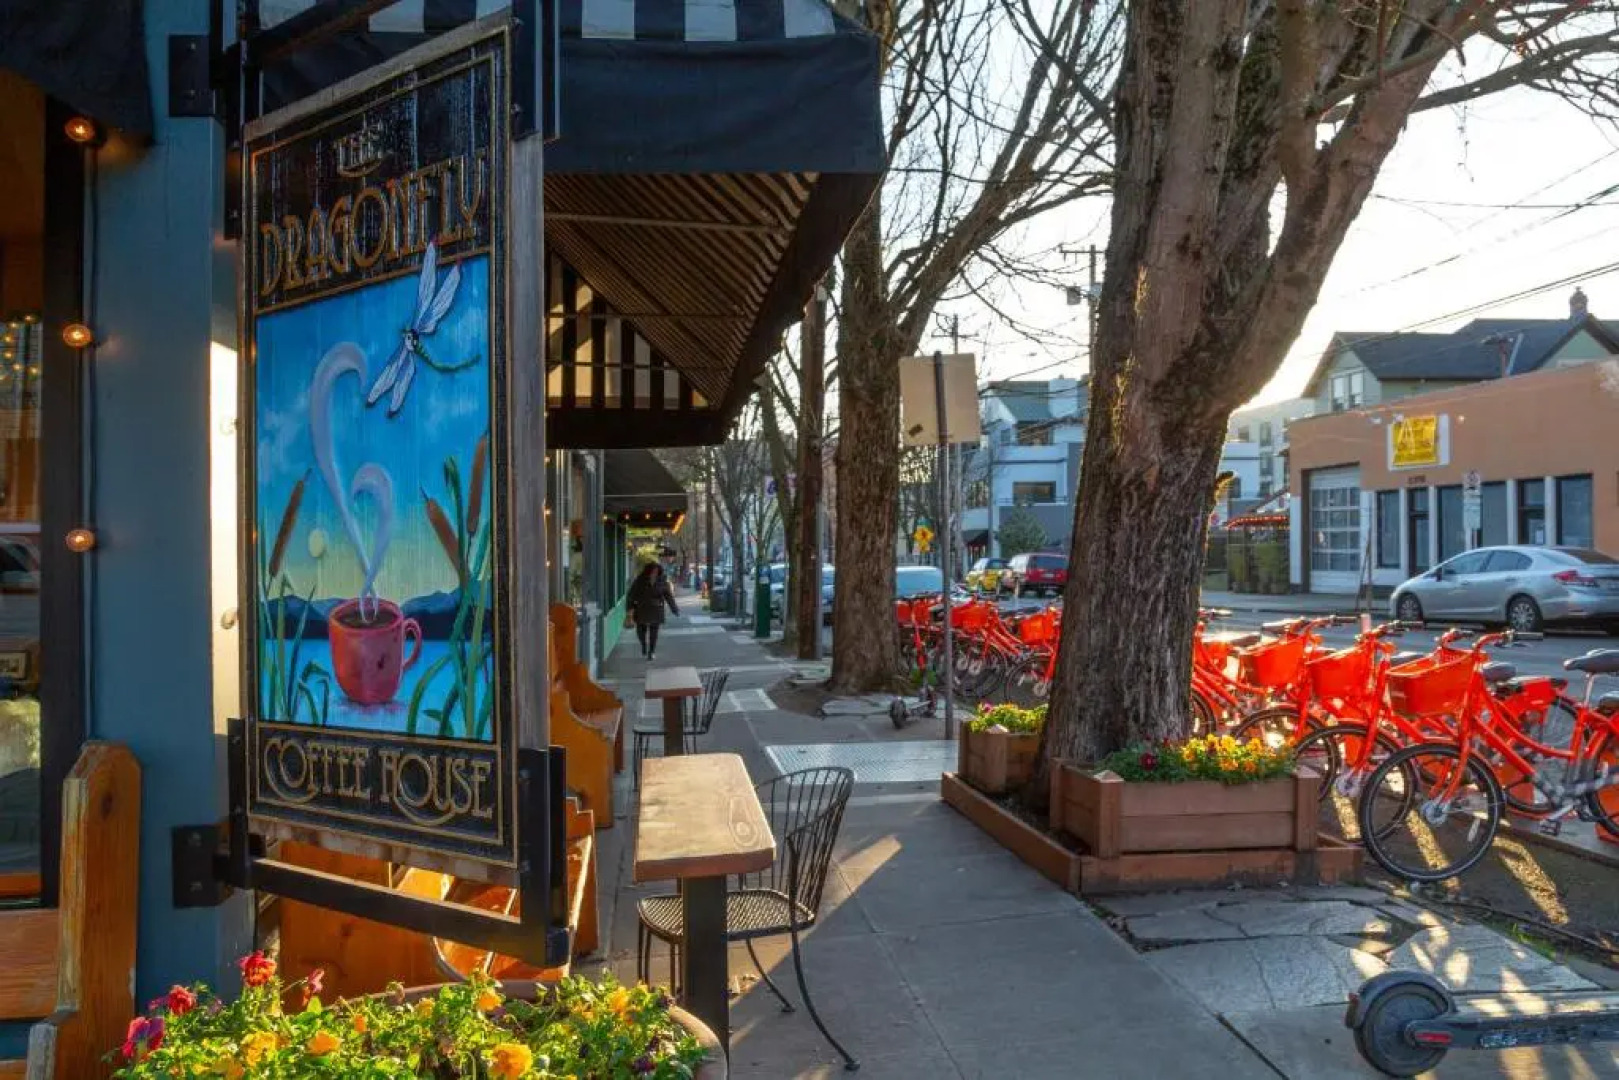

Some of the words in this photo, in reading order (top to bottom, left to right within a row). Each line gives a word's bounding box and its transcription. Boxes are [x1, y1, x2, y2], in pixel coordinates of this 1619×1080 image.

[260, 151, 487, 296] DRAGONFLY
[265, 738, 370, 803] COFFEE
[379, 749, 493, 826] HOUSE
